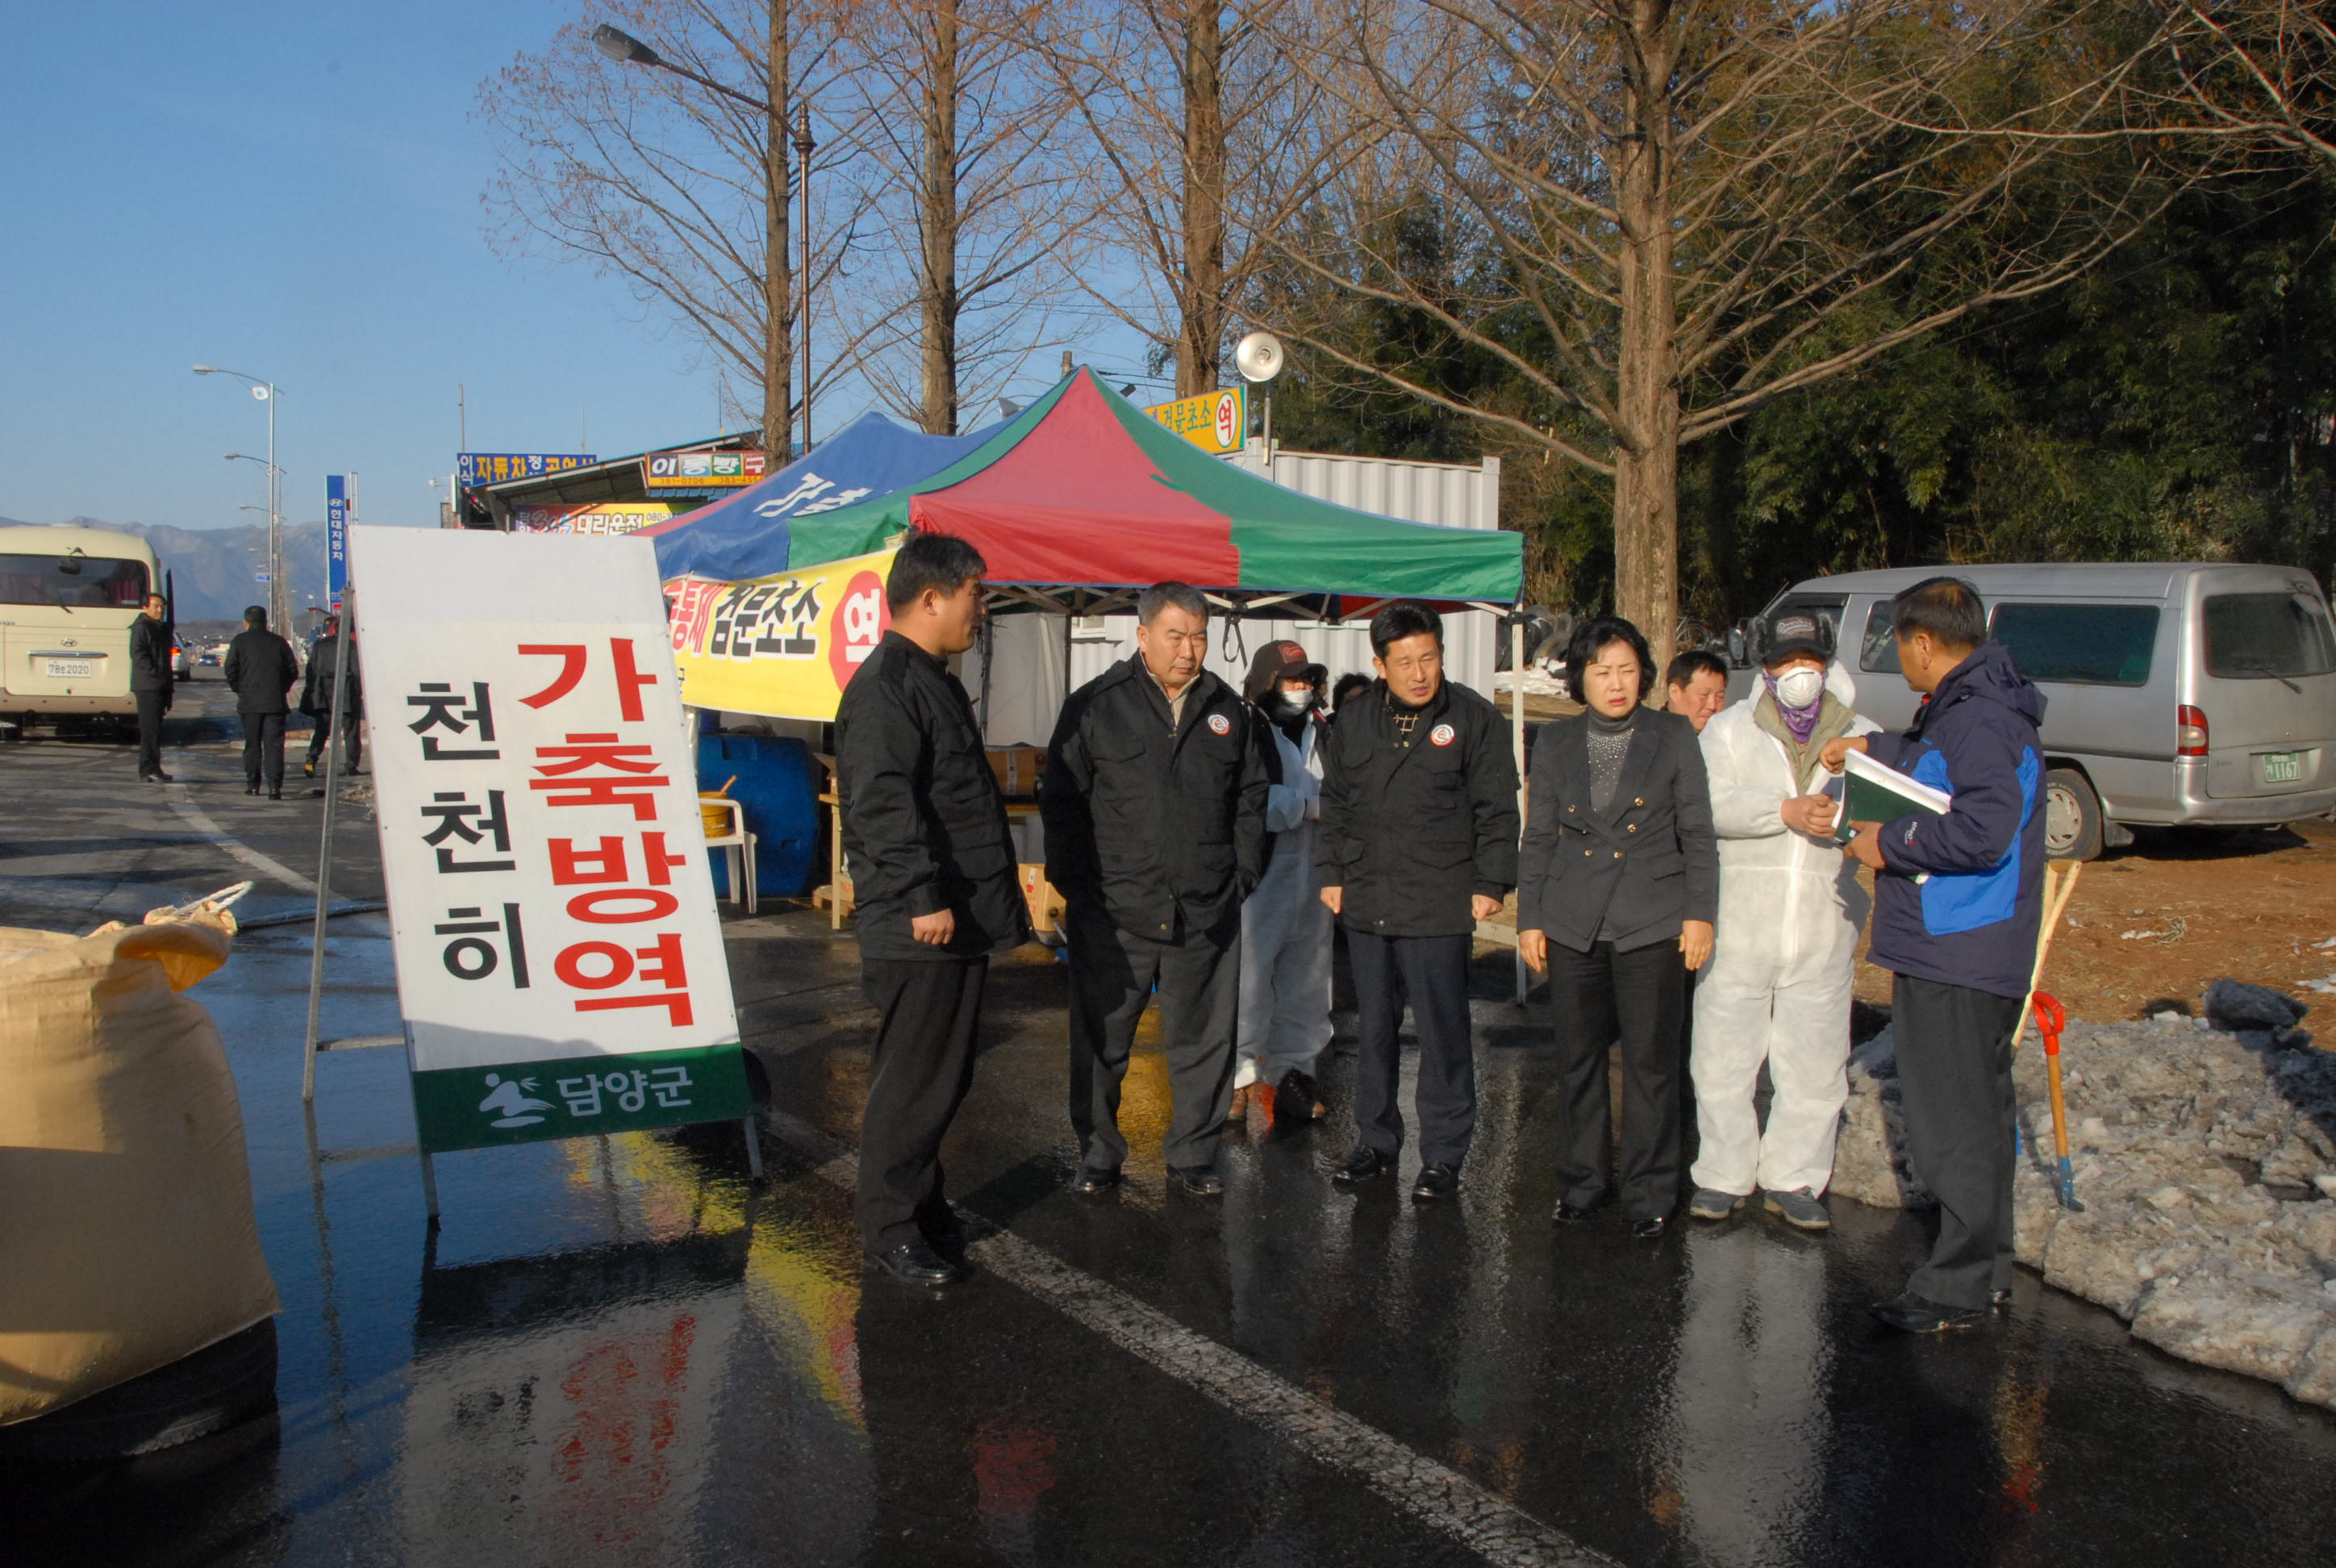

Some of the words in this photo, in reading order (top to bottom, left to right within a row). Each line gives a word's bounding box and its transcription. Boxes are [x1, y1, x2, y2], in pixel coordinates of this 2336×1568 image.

[1218, 399, 1232, 440] 역
[477, 456, 528, 482] 자동차
[332, 509, 344, 562] 현대자동차
[406, 681, 531, 990] 천천히
[517, 637, 695, 1027] 가축방역
[555, 1065, 694, 1117] 담양군
